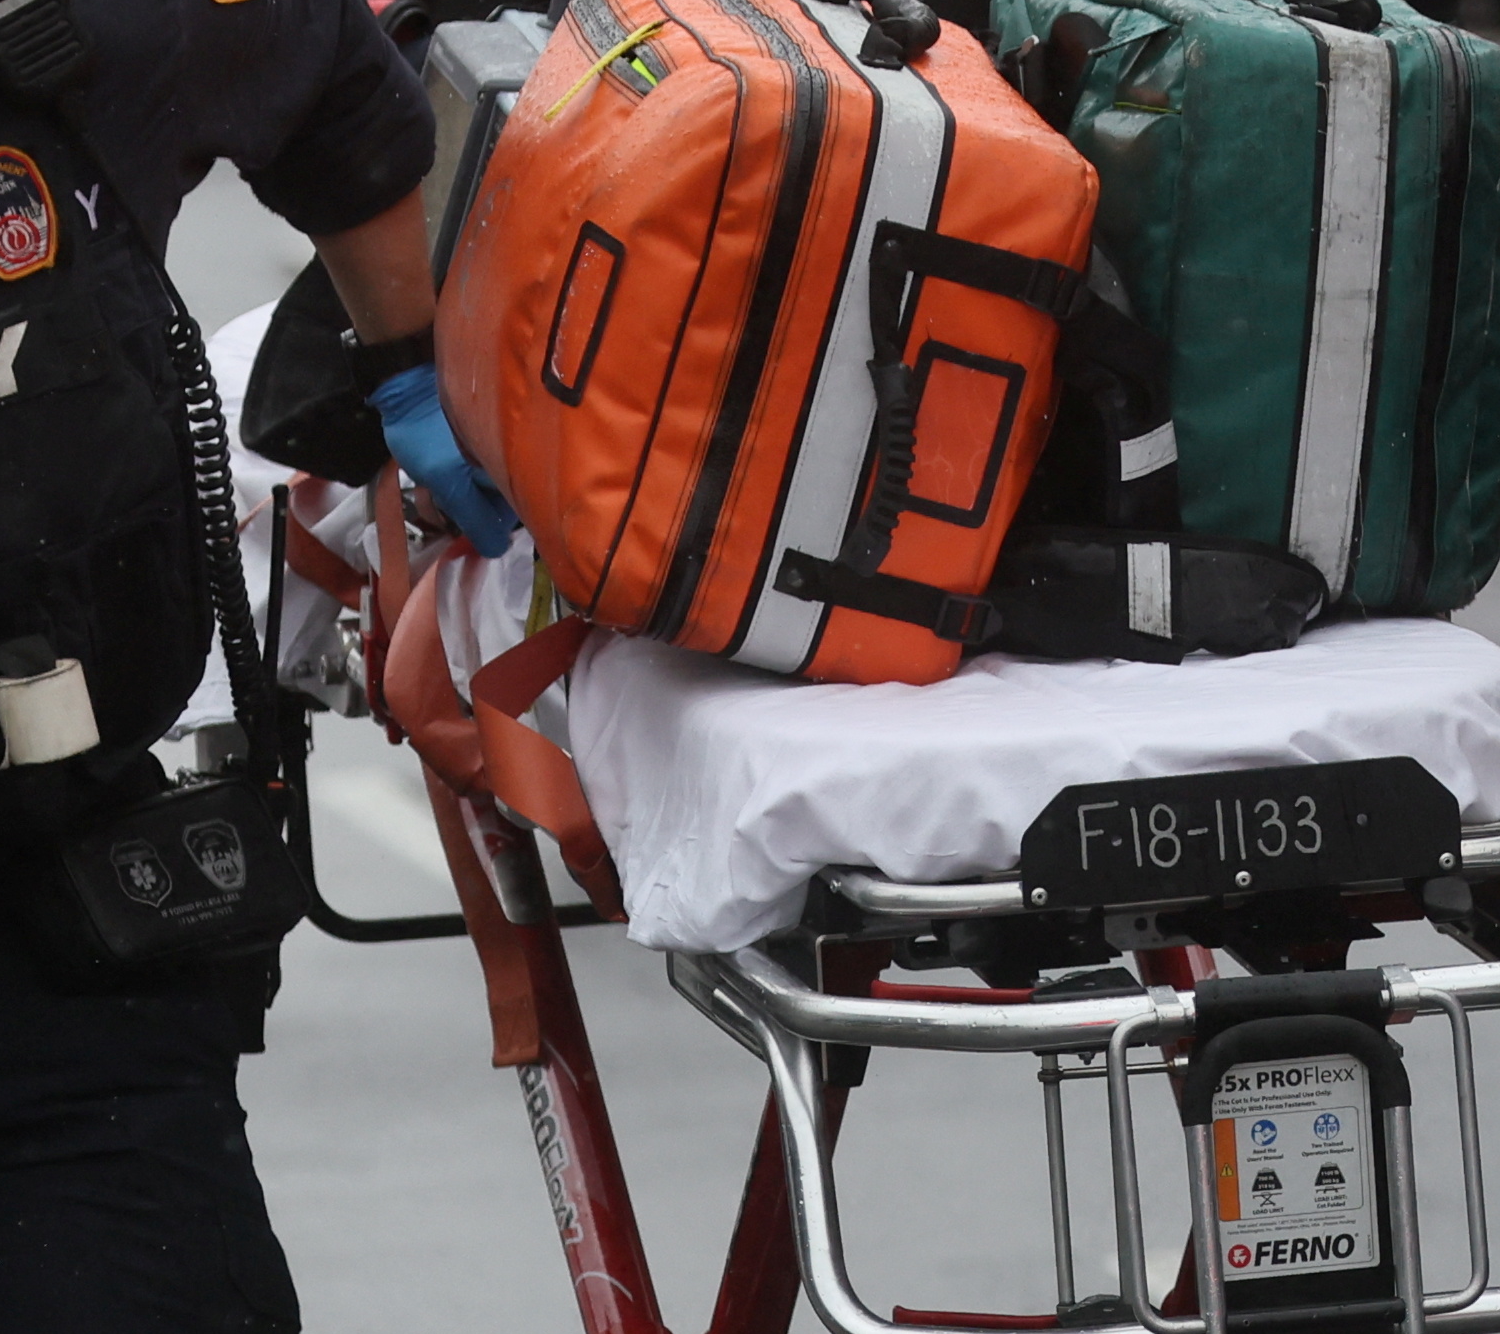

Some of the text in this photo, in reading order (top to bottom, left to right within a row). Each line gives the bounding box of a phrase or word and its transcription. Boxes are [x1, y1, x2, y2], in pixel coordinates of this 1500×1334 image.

[1256, 1065, 1356, 1090] PROFlexx
[1218, 1098, 1230, 1106] The
[1231, 1097, 1242, 1105] Cot
[1261, 1092, 1301, 1102] Professional
[1232, 1106, 1247, 1115] Only
[1254, 1234, 1355, 1267] FERNO
